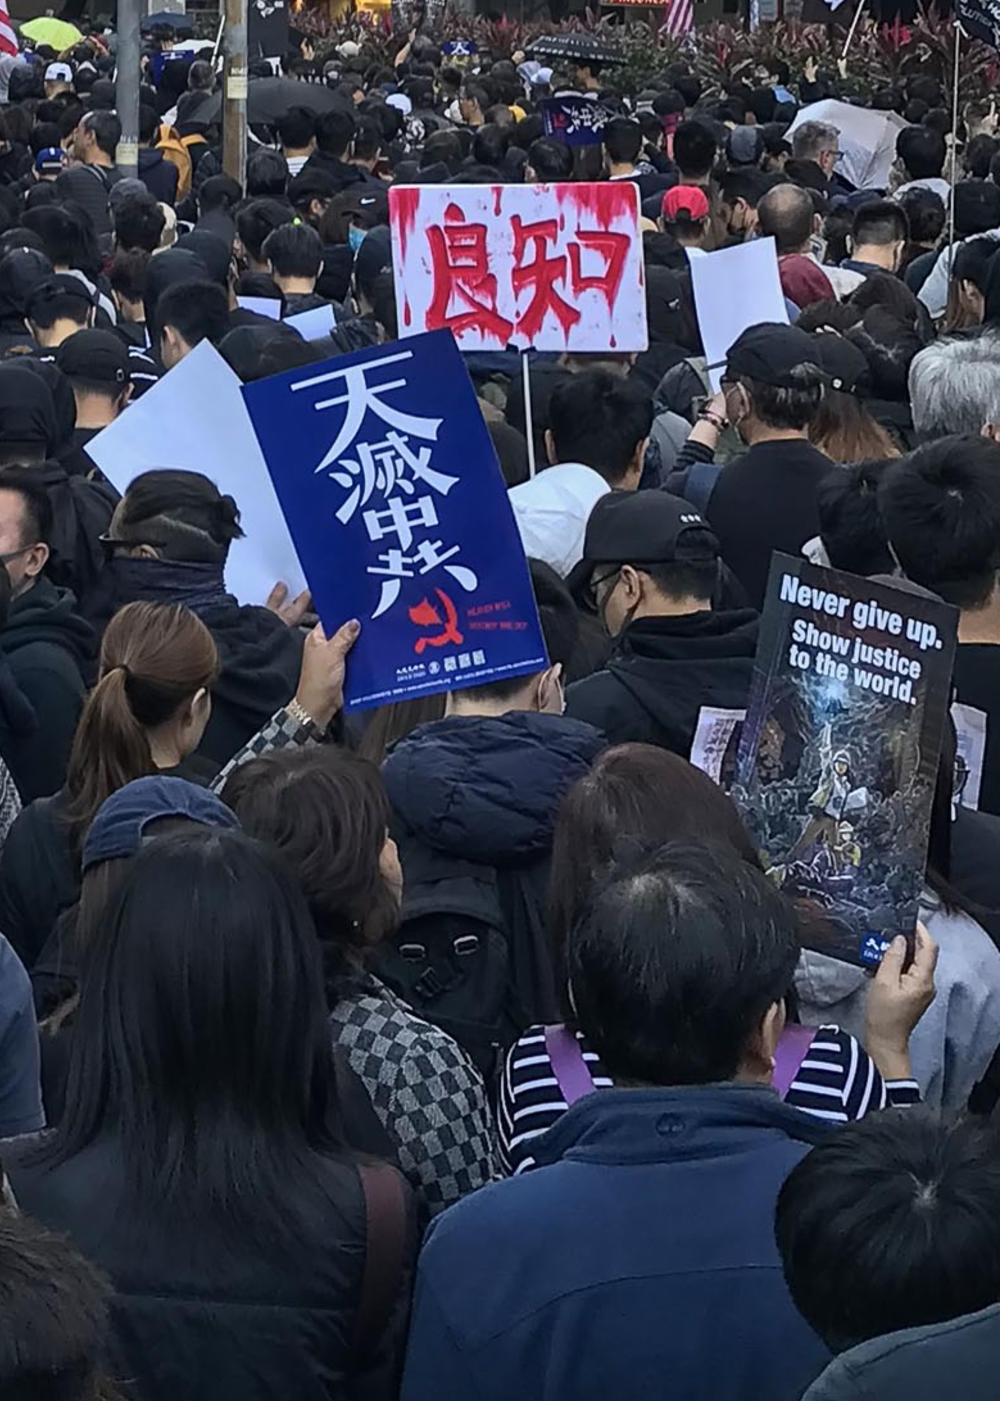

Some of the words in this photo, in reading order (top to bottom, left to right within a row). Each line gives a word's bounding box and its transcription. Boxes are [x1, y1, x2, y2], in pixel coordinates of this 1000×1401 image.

[425, 202, 631, 345] 良知
[290, 350, 479, 620] 天滅中共
[780, 574, 850, 618] Never
[852, 600, 903, 635] give
[906, 618, 943, 650] up.
[791, 619, 851, 656] Show
[851, 637, 922, 680] justice
[789, 644, 811, 670] to
[815, 652, 850, 681] the
[854, 668, 917, 705] world.
